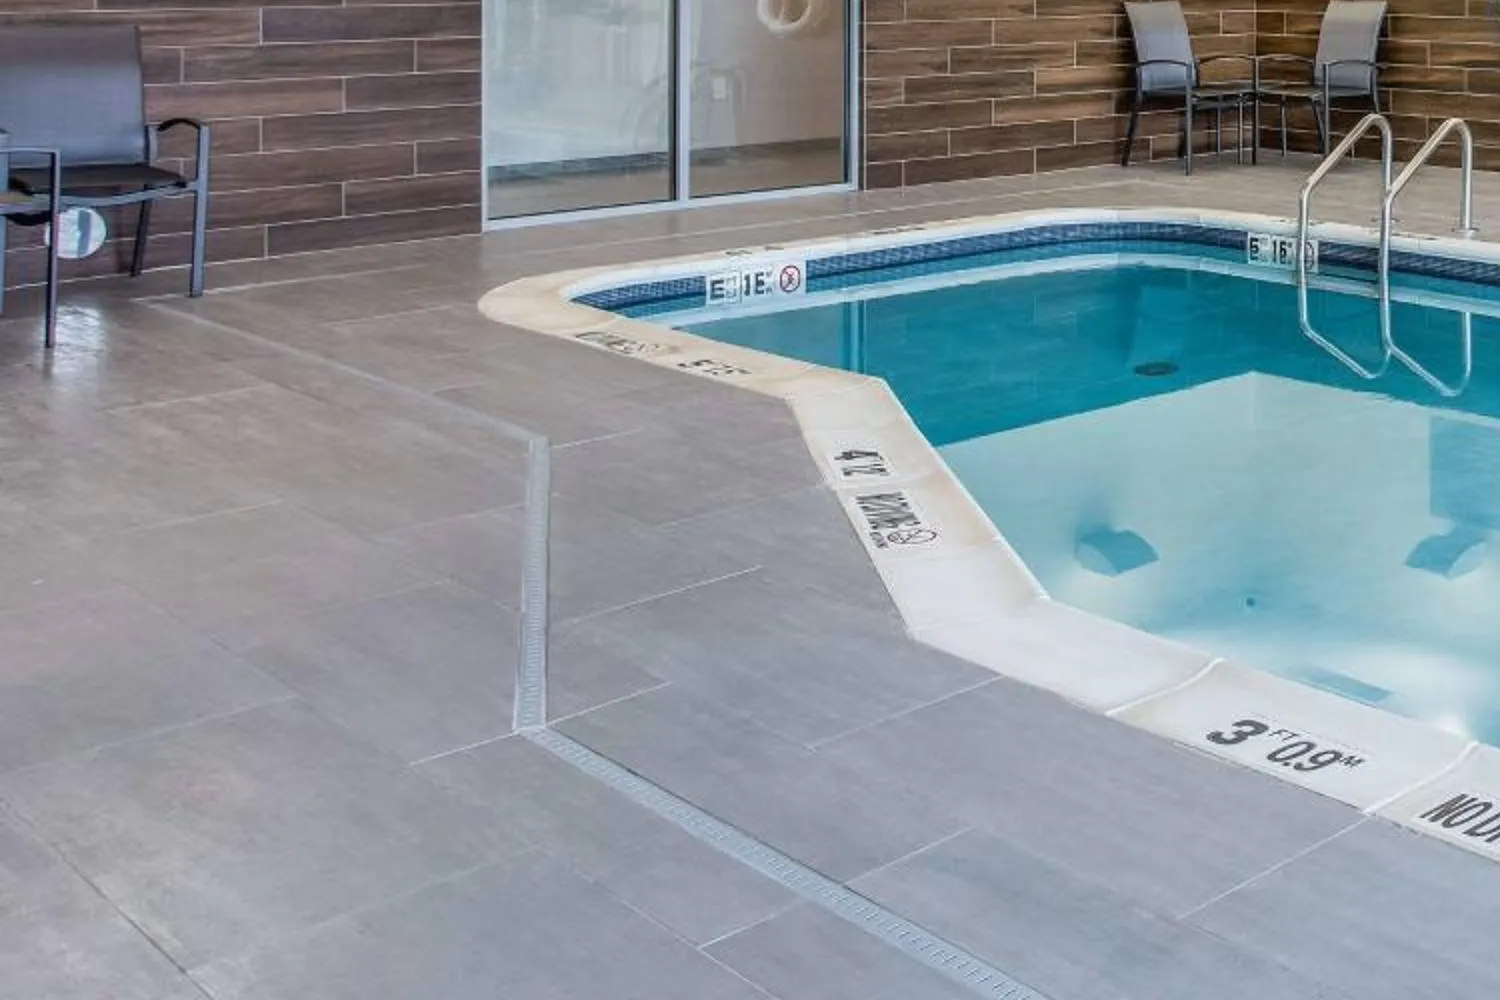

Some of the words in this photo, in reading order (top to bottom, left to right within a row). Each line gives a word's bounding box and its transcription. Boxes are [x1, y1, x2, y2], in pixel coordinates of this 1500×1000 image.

[1206, 720, 1269, 745] 3
[1268, 729, 1298, 742] FT
[1267, 741, 1343, 771] 0.9
[1419, 793, 1494, 829] NO
